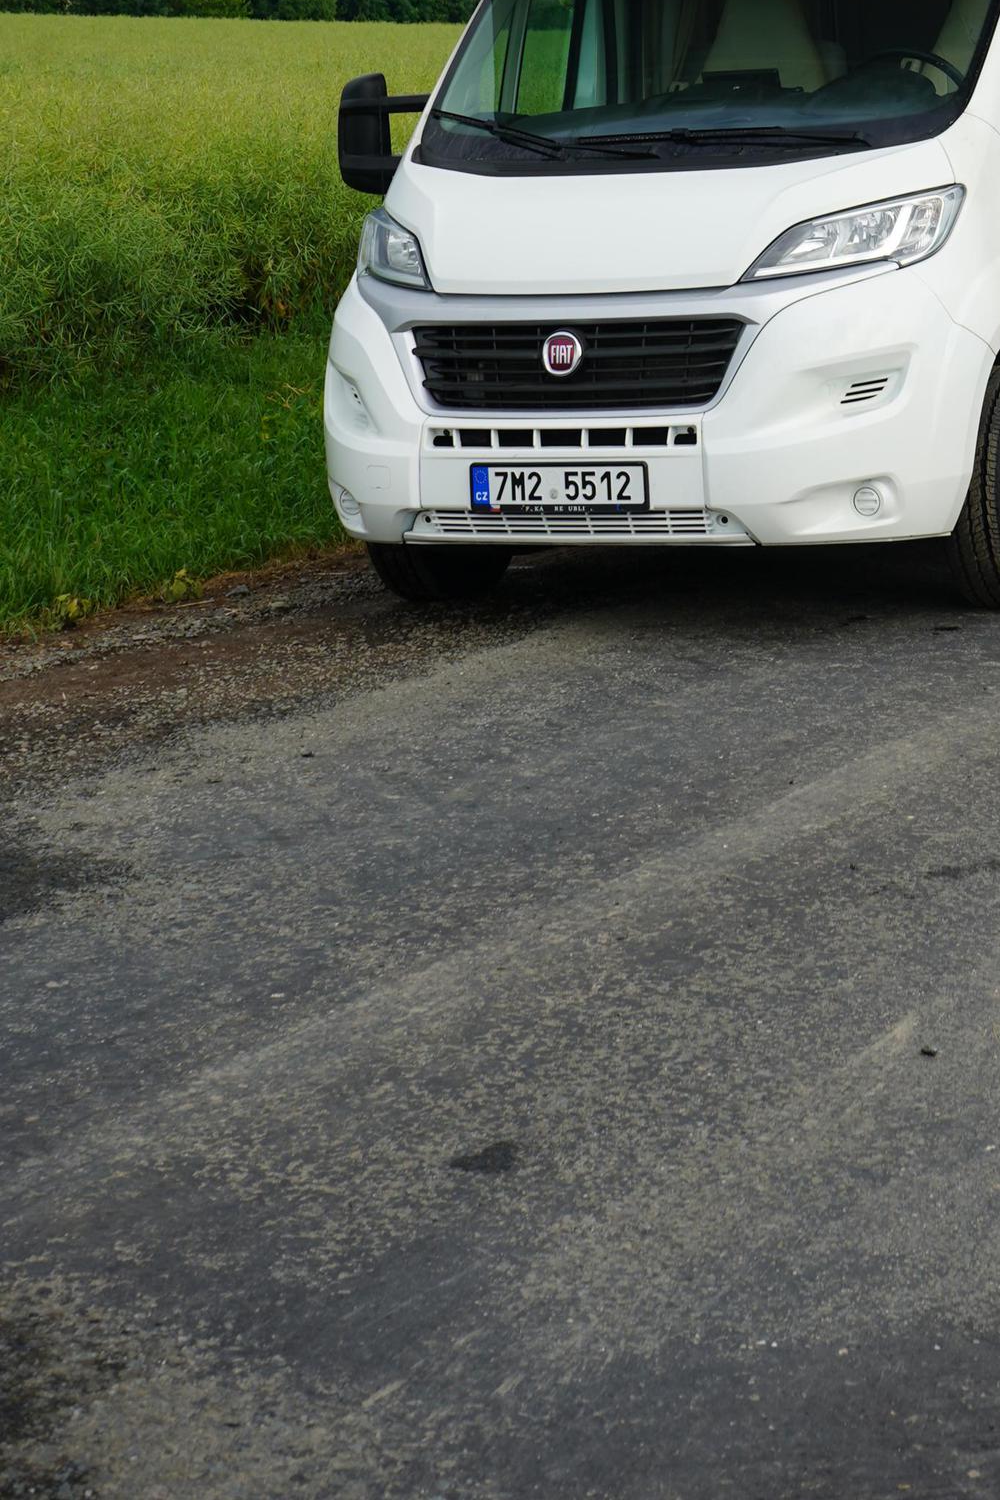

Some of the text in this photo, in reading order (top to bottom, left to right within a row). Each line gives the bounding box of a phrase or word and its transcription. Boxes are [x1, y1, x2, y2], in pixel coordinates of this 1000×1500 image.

[551, 345, 574, 364] FIAT
[475, 471, 632, 501] CZ 7M2 5512
